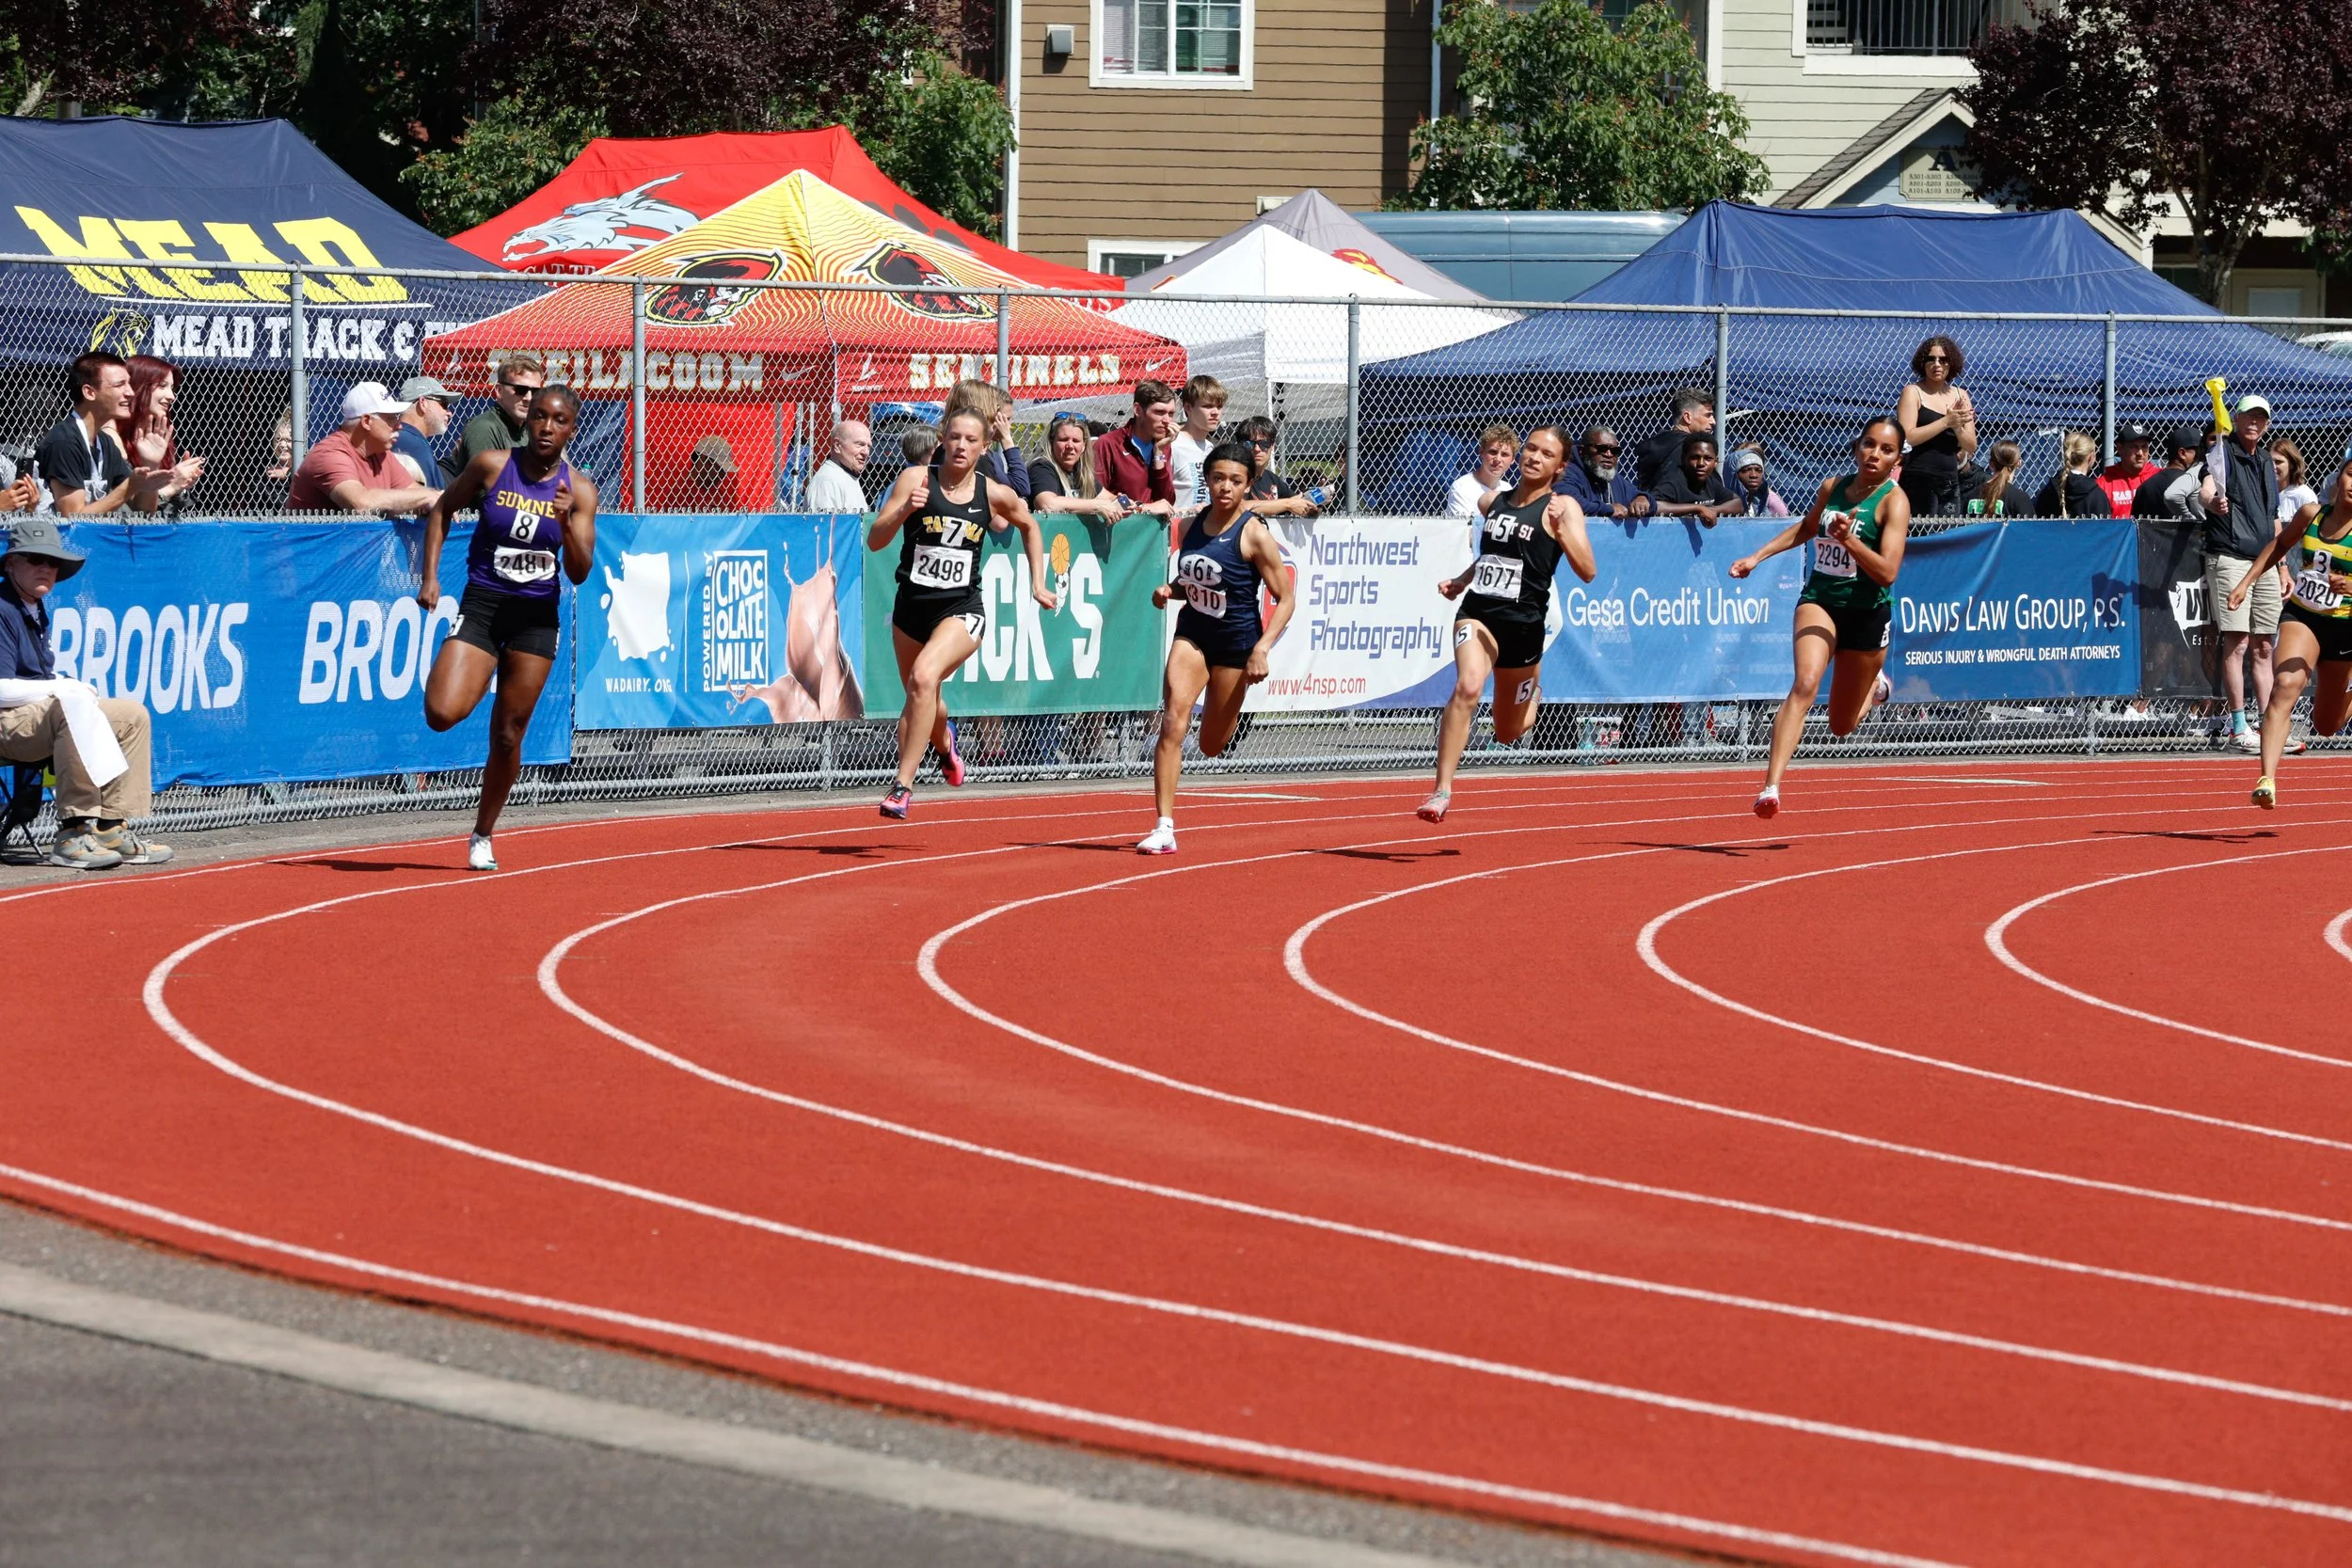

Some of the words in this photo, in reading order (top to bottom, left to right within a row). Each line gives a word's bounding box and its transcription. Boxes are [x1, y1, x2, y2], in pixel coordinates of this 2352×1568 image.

[1928, 151, 1960, 171] A
[14, 205, 408, 303] MEAD
[153, 315, 255, 358] MEAD
[496, 490, 556, 518] SUMNE
[515, 514, 533, 541] 8
[946, 519, 963, 544] 7
[1495, 516, 1511, 540] 5
[1518, 524, 1534, 541] SI
[1309, 532, 1420, 566] Northwest
[1818, 543, 1851, 569] 2294
[500, 553, 547, 576] 2481
[704, 551, 714, 578] BY
[917, 554, 965, 583] 2498
[1193, 558, 1205, 582] 6
[2315, 551, 2328, 575] 3
[716, 560, 764, 608] CHOC
[1477, 564, 1516, 590] 1677
[1309, 574, 1379, 614] Sports
[2296, 577, 2338, 608] 2020
[716, 591, 764, 640] OLATE
[1566, 587, 1626, 627] Gesa
[1630, 587, 1701, 626] Credit
[1707, 586, 1770, 626] Union
[1899, 596, 1961, 633] DAVIS
[1965, 595, 2010, 632] LAW
[2014, 594, 2088, 633] GROUP,
[2093, 596, 2126, 628] P.S.
[703, 584, 711, 692] POWERED
[1311, 617, 1444, 659] Photography
[1458, 626, 1469, 645] 5
[53, 602, 248, 715] BROOKS
[716, 641, 765, 681] MILK
[1905, 651, 1943, 665] SERIOUS
[1945, 649, 1976, 664] INJURY
[1978, 650, 1985, 663] &
[1986, 649, 2037, 663] WRONGFUL
[2039, 647, 2068, 661] DEATH
[2070, 645, 2121, 660] ATTORNEYS
[1267, 672, 1367, 699] www.4nsp.com
[1518, 680, 1531, 704] 5
